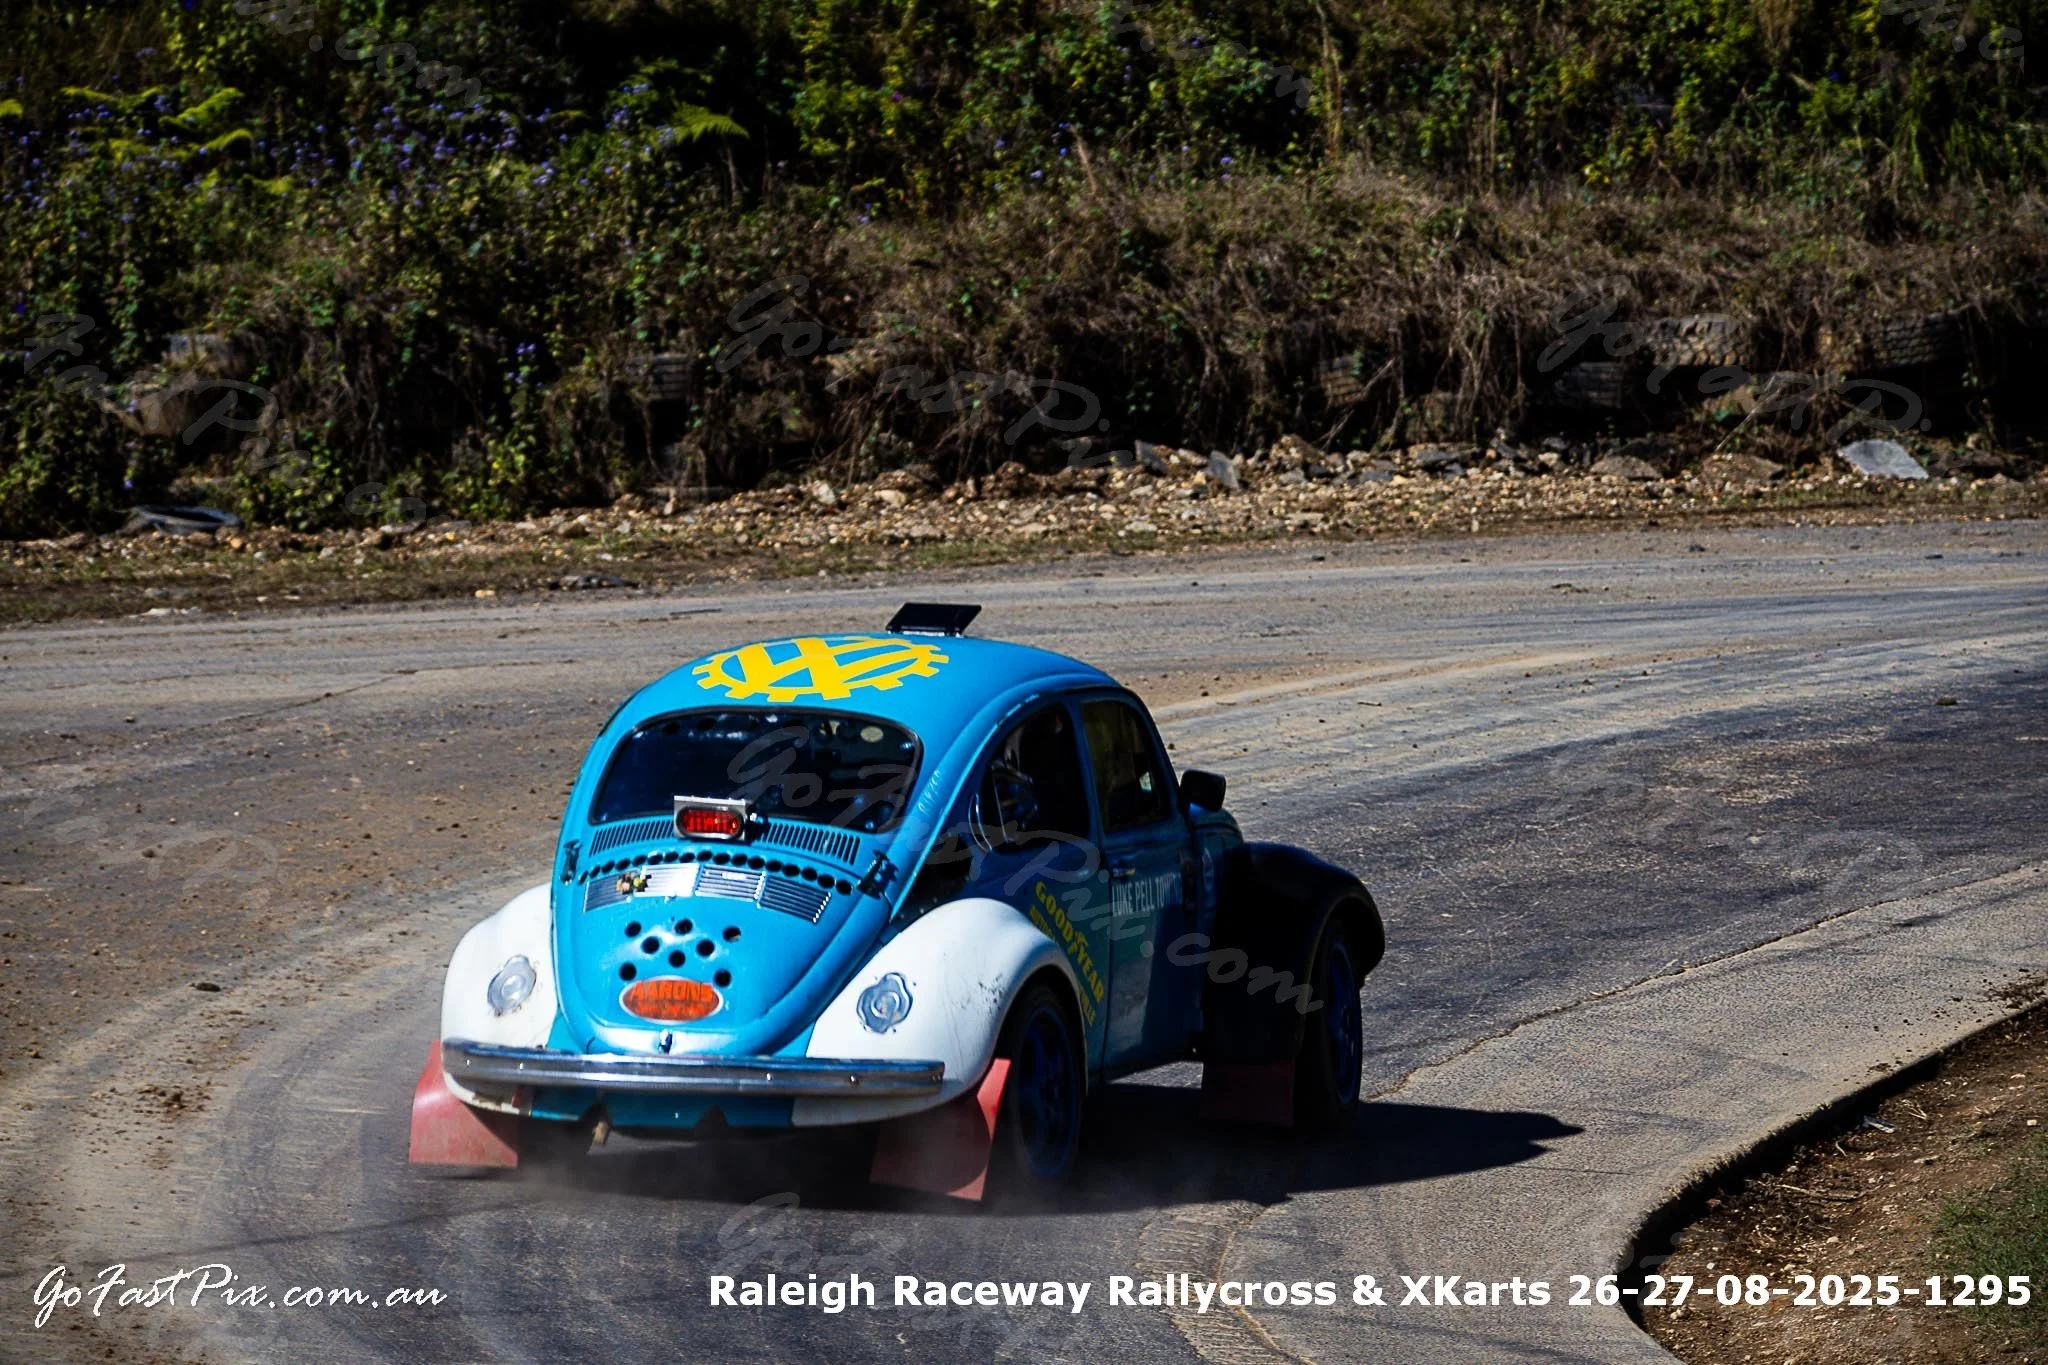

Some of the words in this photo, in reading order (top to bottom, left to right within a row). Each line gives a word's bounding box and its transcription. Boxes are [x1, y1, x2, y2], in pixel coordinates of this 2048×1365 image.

[1111, 881, 1134, 918] LUKE
[1135, 876, 1155, 913] PELL
[1035, 880, 1105, 1004] GOODYEAR
